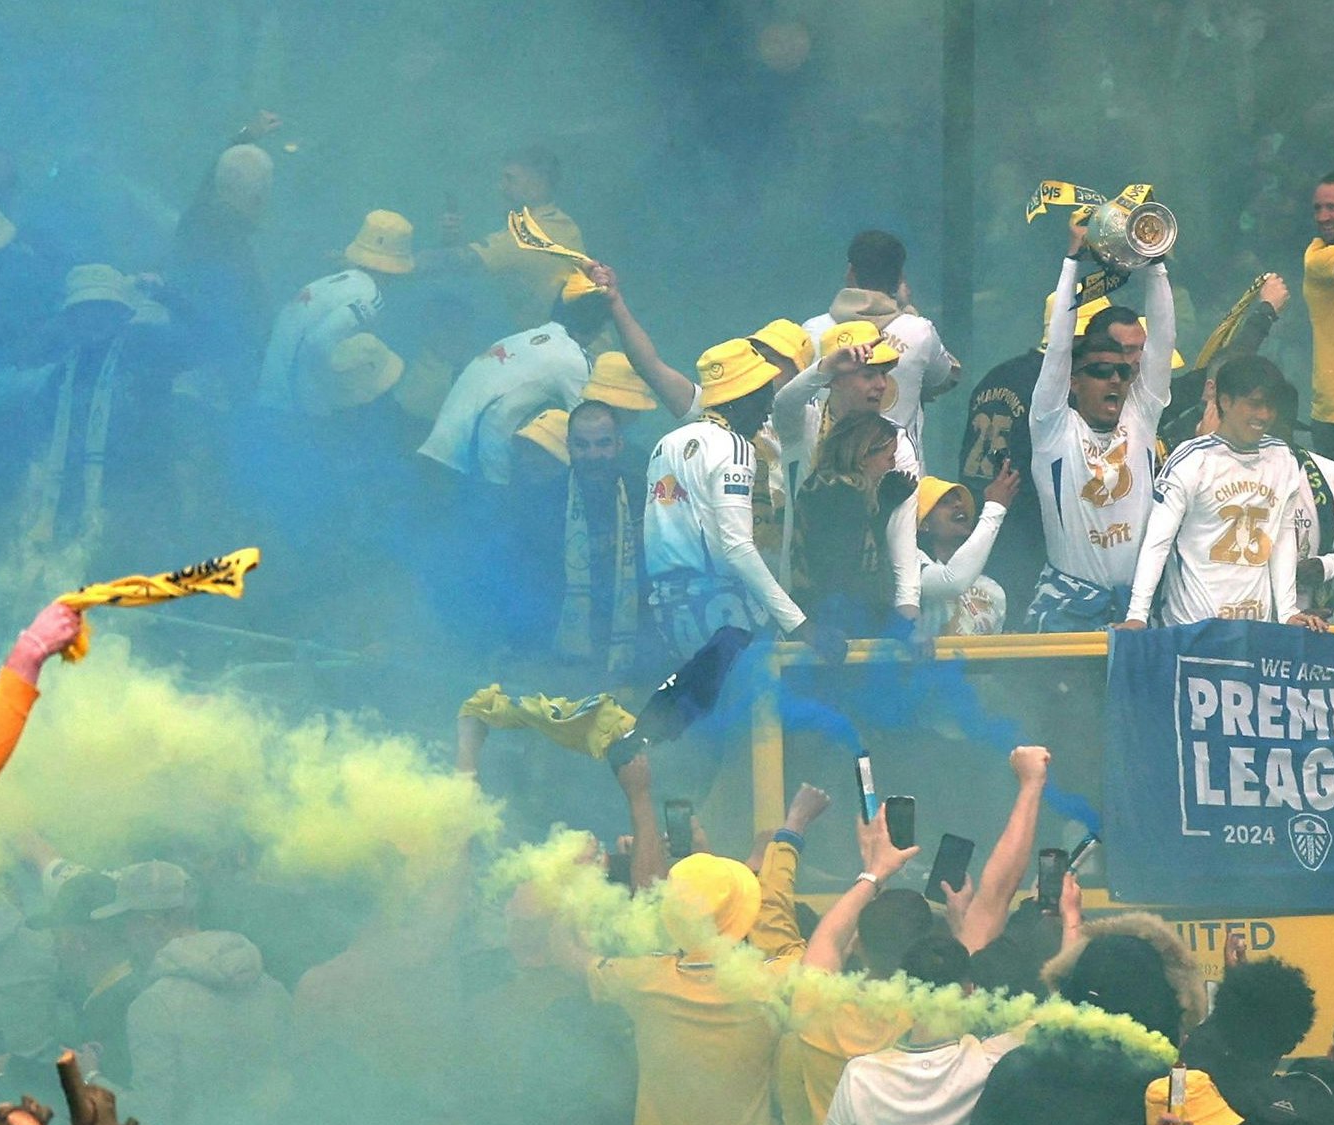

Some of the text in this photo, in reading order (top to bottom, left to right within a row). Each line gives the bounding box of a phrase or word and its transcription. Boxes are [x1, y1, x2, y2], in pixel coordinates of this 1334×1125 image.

[1209, 504, 1273, 568] 25
[1261, 657, 1292, 679] WE
[1223, 825, 1275, 845] 2024
[1177, 921, 1276, 952] ITED
